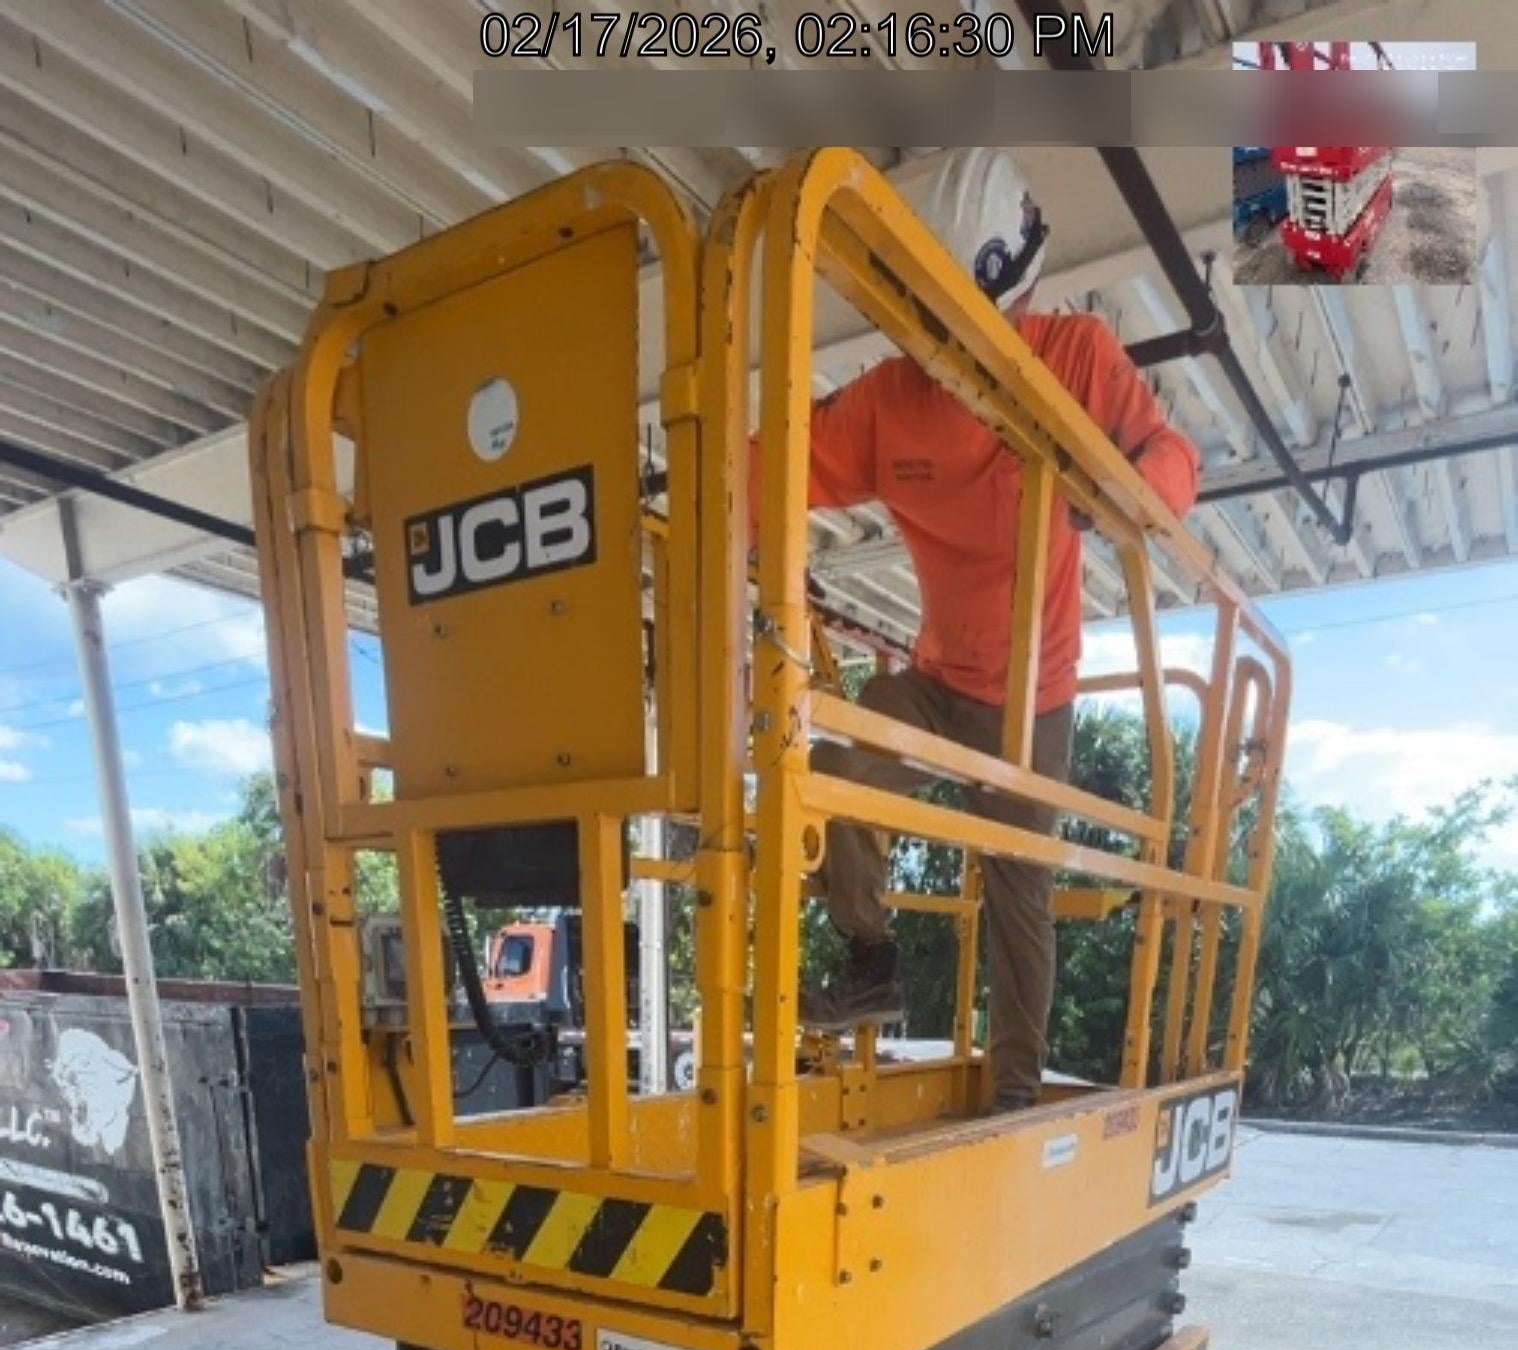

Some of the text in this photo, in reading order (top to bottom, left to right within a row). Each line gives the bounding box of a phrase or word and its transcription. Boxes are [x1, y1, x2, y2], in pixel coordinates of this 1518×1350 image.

[411, 478, 591, 596] JCB
[1151, 1089, 1237, 1196] JCB
[0, 1191, 144, 1264] 6-1461
